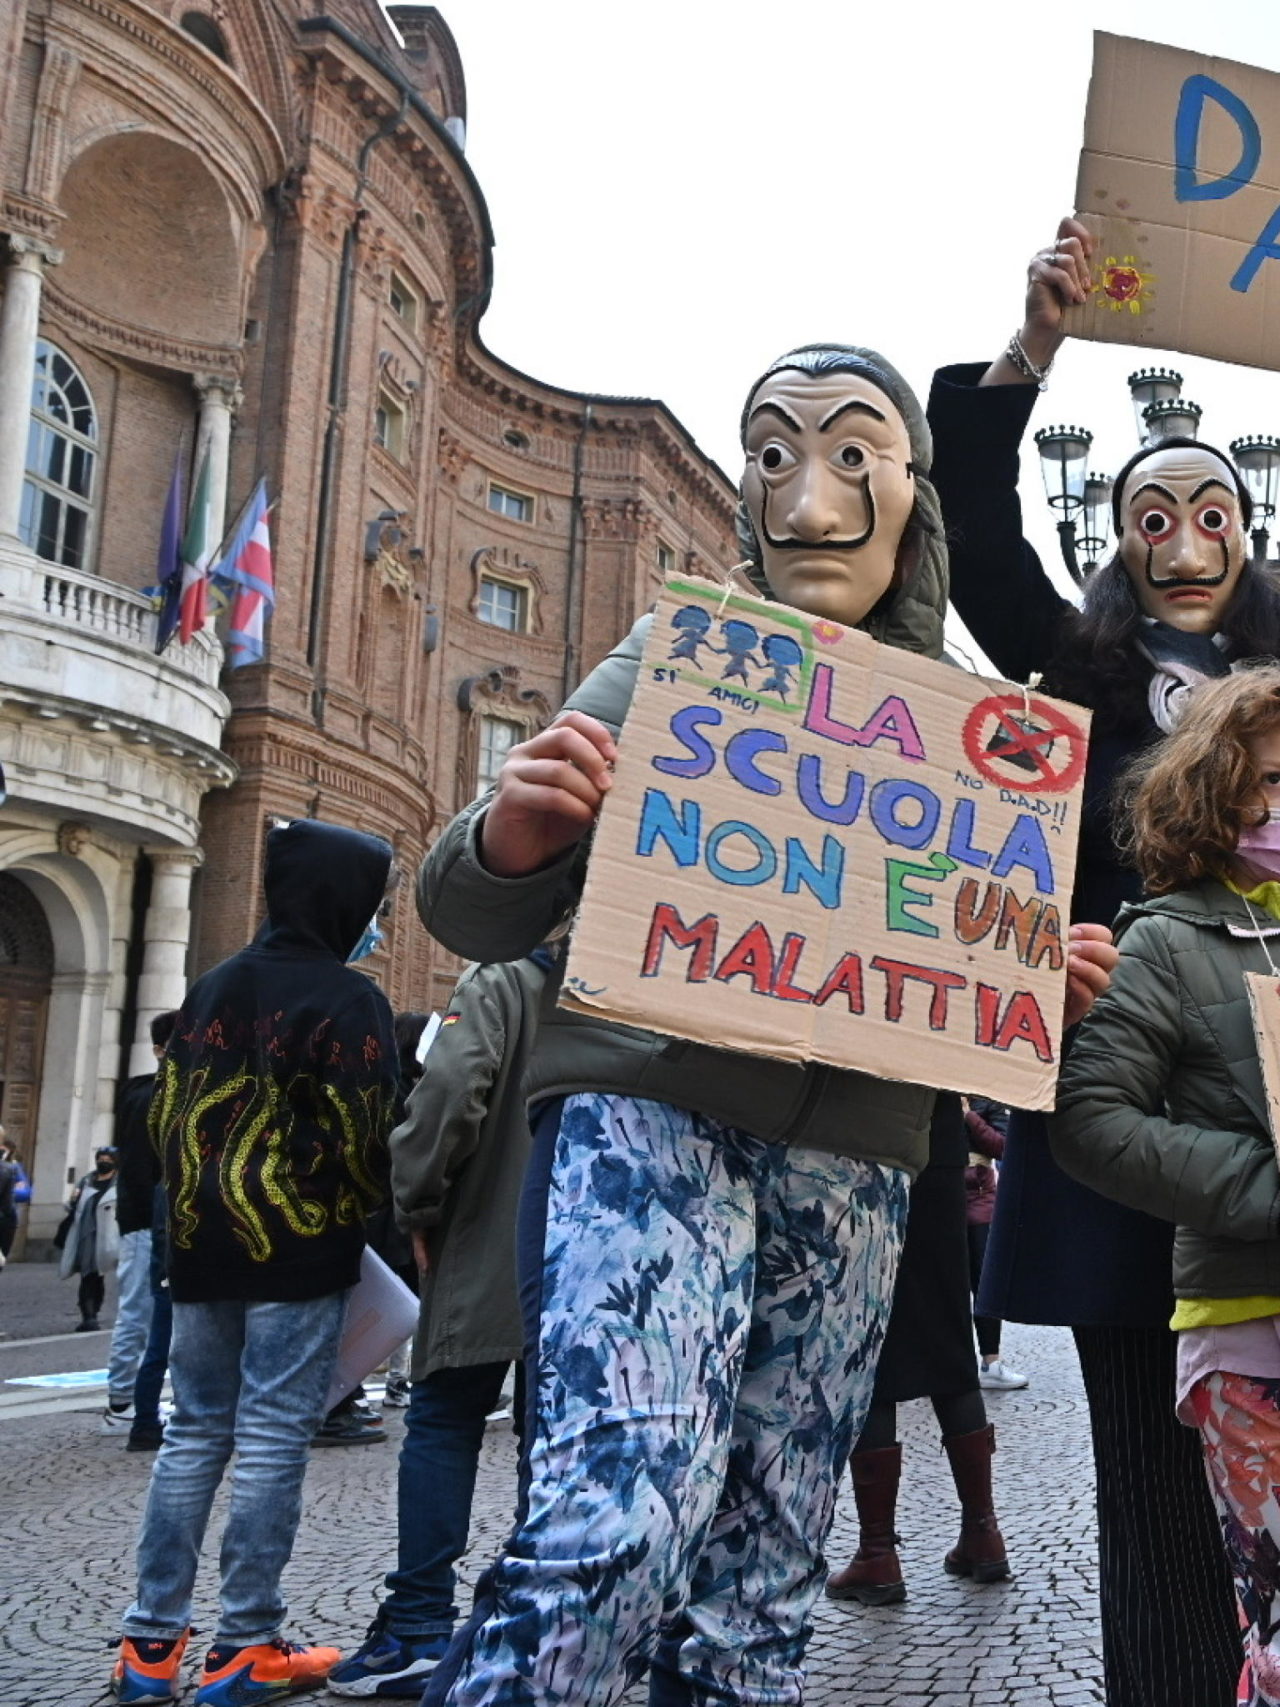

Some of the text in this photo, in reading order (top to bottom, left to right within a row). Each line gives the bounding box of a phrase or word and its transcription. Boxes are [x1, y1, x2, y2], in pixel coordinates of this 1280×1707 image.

[708, 686, 760, 714] AMICI
[804, 663, 926, 763] LA
[652, 705, 1055, 895] SCUOLA
[954, 769, 983, 790] NO
[636, 788, 845, 909] NON
[954, 877, 1064, 970] UNA
[640, 903, 1054, 1063] MALATTIA
